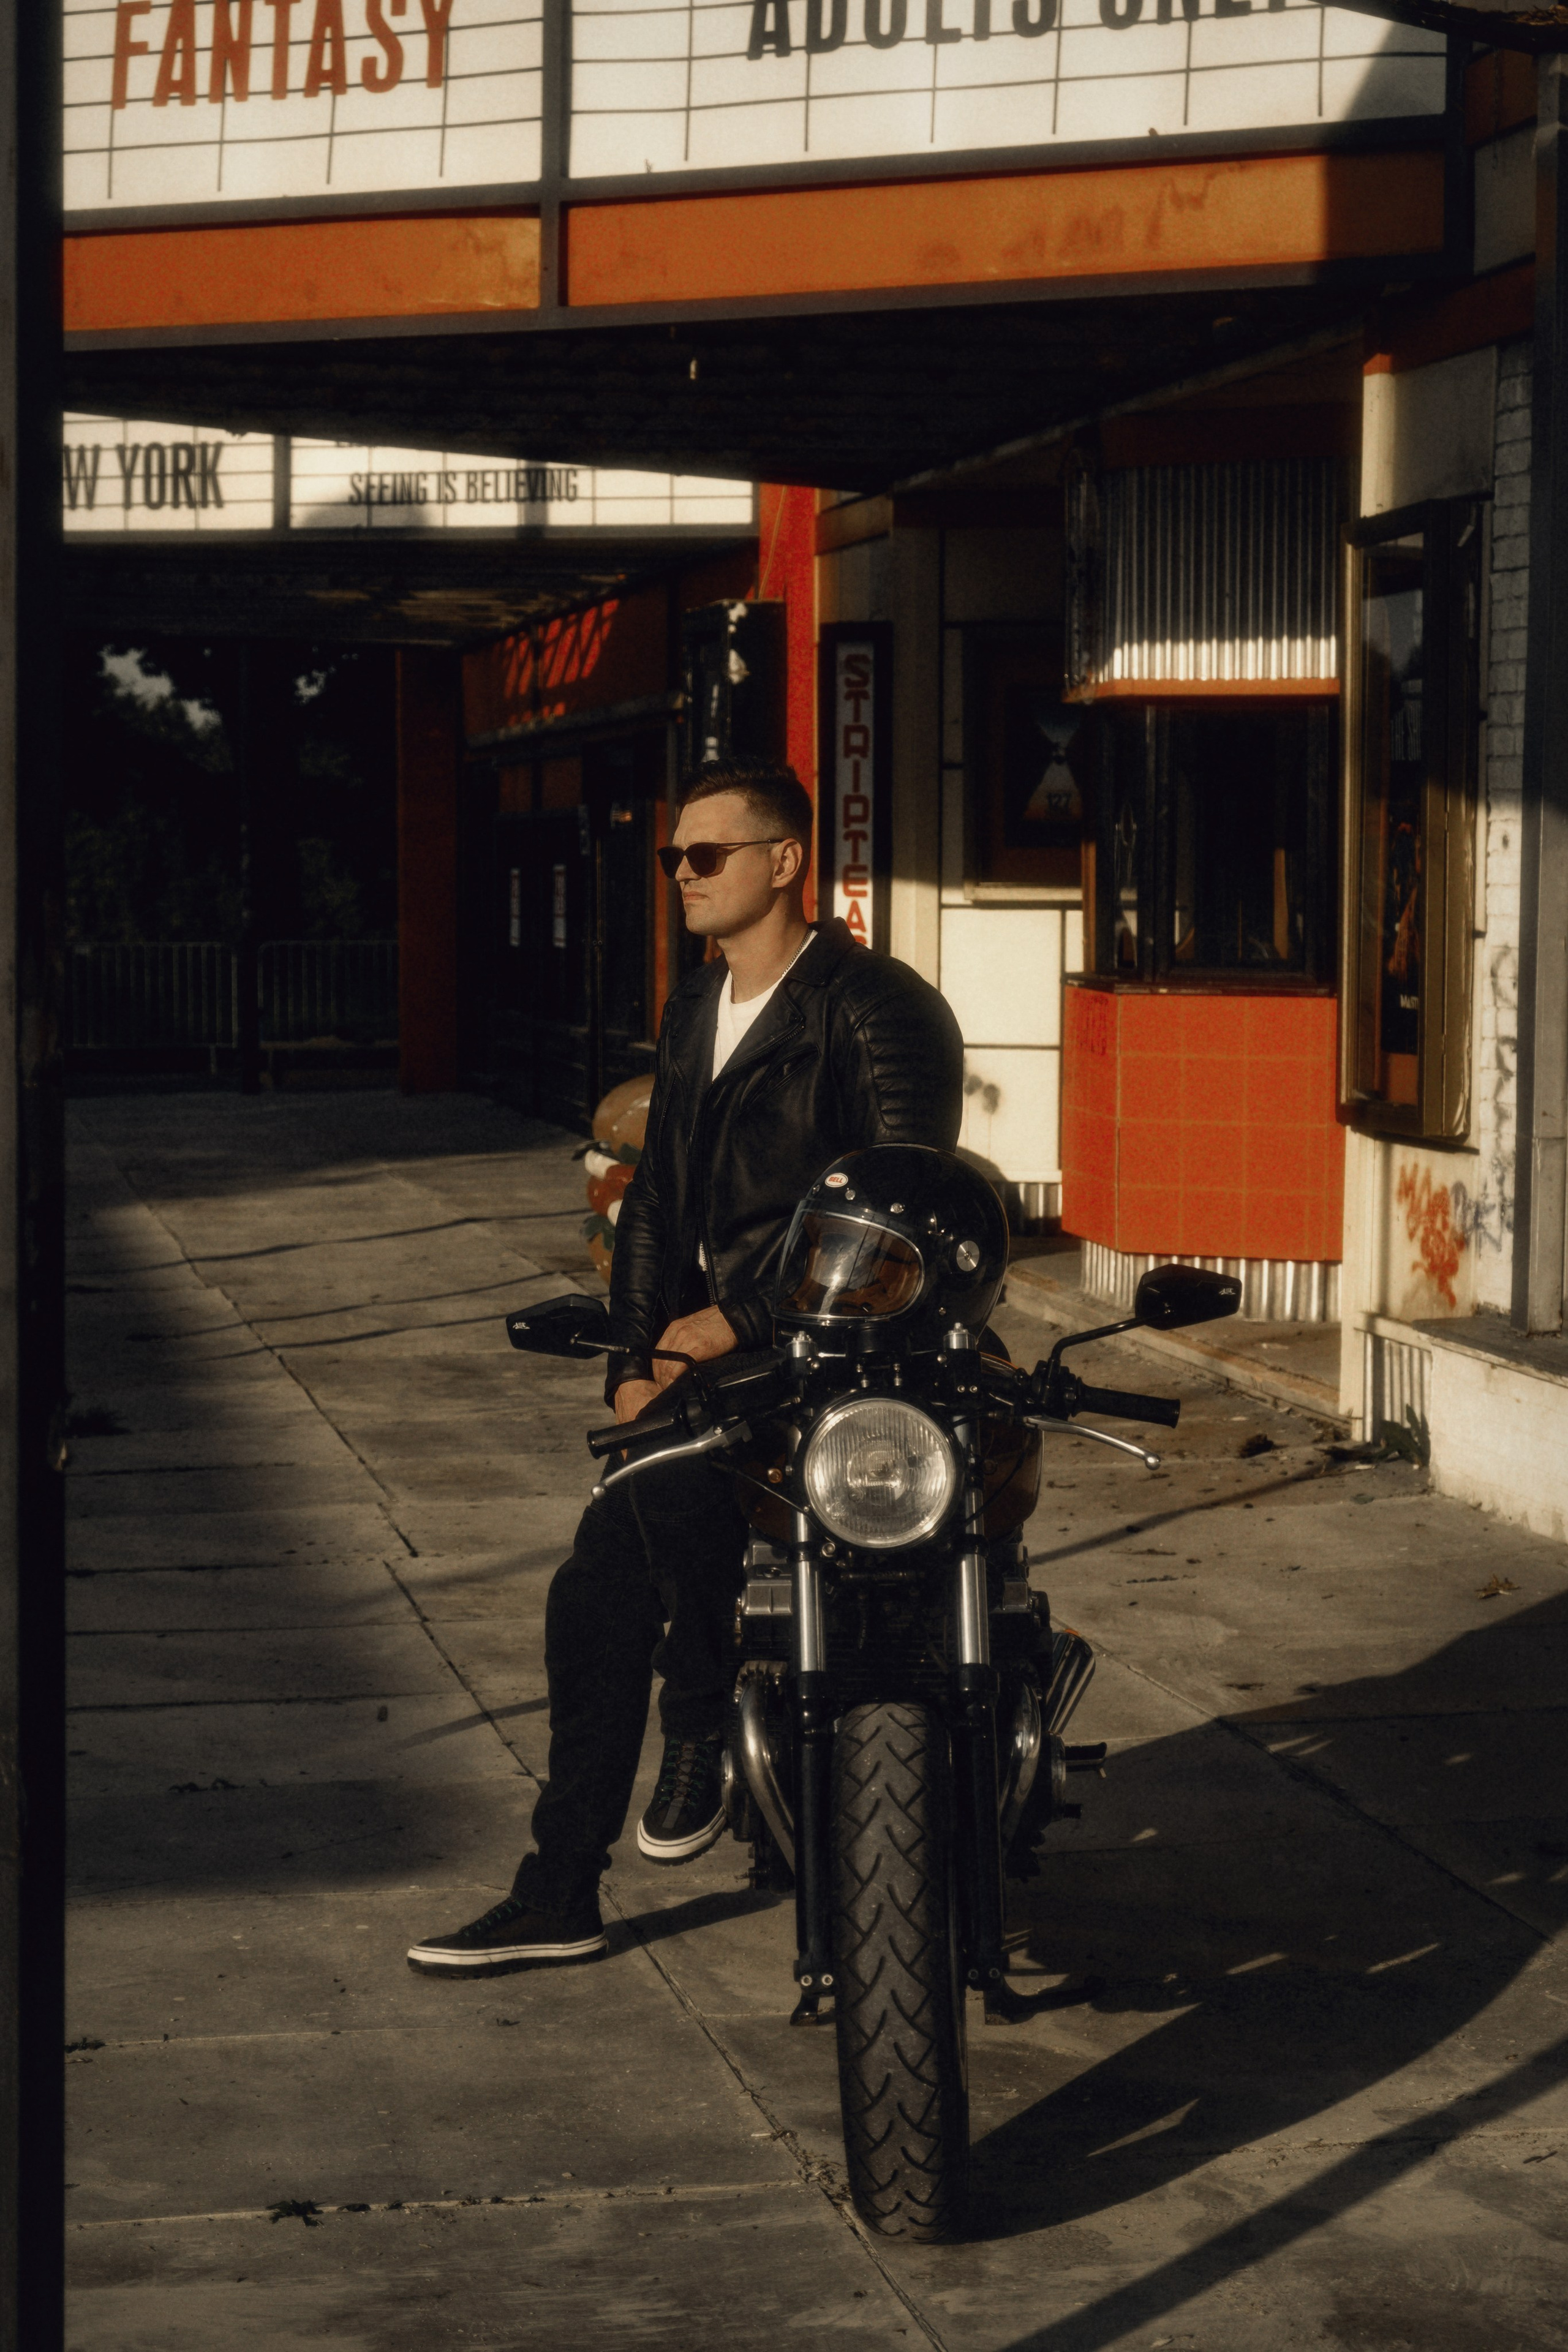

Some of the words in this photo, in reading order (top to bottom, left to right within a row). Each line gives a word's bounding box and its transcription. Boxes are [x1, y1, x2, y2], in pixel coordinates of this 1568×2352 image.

[112, 0, 454, 110] FANTASY
[116, 440, 225, 510] YORK
[348, 471, 428, 505] SEEING
[437, 470, 458, 504] IS
[466, 467, 578, 503] BELIEVING
[842, 653, 871, 944] STRIPTEA
[1400, 993, 1419, 1010] MAST
